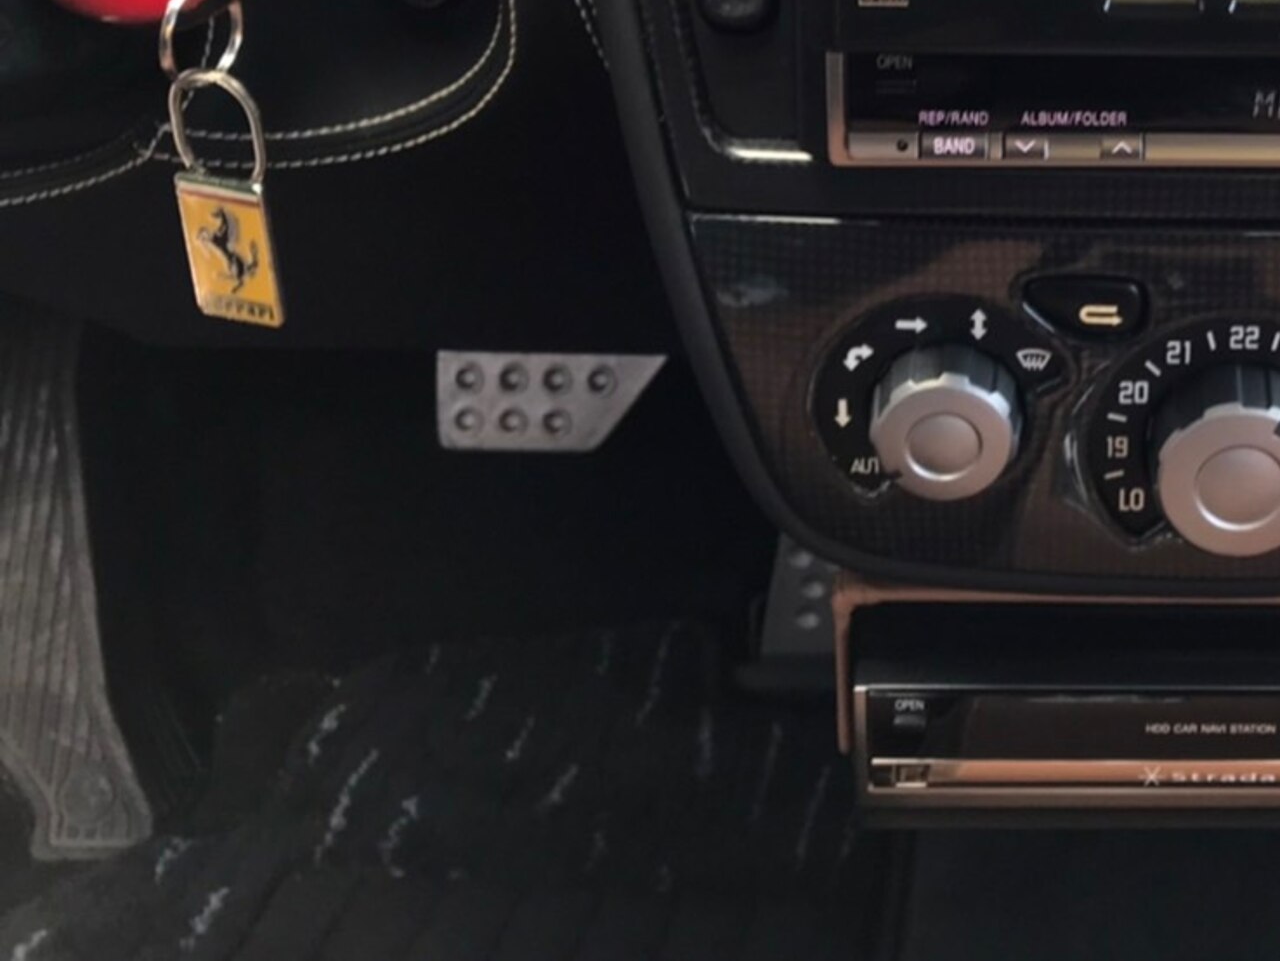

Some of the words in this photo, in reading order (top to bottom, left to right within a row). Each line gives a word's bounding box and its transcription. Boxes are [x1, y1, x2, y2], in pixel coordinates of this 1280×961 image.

[876, 55, 913, 70] OPEN
[918, 110, 989, 127] REP/RAND
[1020, 110, 1128, 127] ALBUM/FOLDER
[933, 137, 976, 155] BAND
[1229, 326, 1260, 350] 22
[1166, 341, 1191, 365] 21
[1119, 381, 1148, 404] 20
[1106, 436, 1128, 458] 19
[1118, 488, 1144, 511] LO
[895, 699, 925, 712] OPEN
[1145, 723, 1170, 734] HDD
[1173, 723, 1198, 734] CAR
[1200, 723, 1227, 734] NAVI
[1229, 723, 1277, 734] STATION
